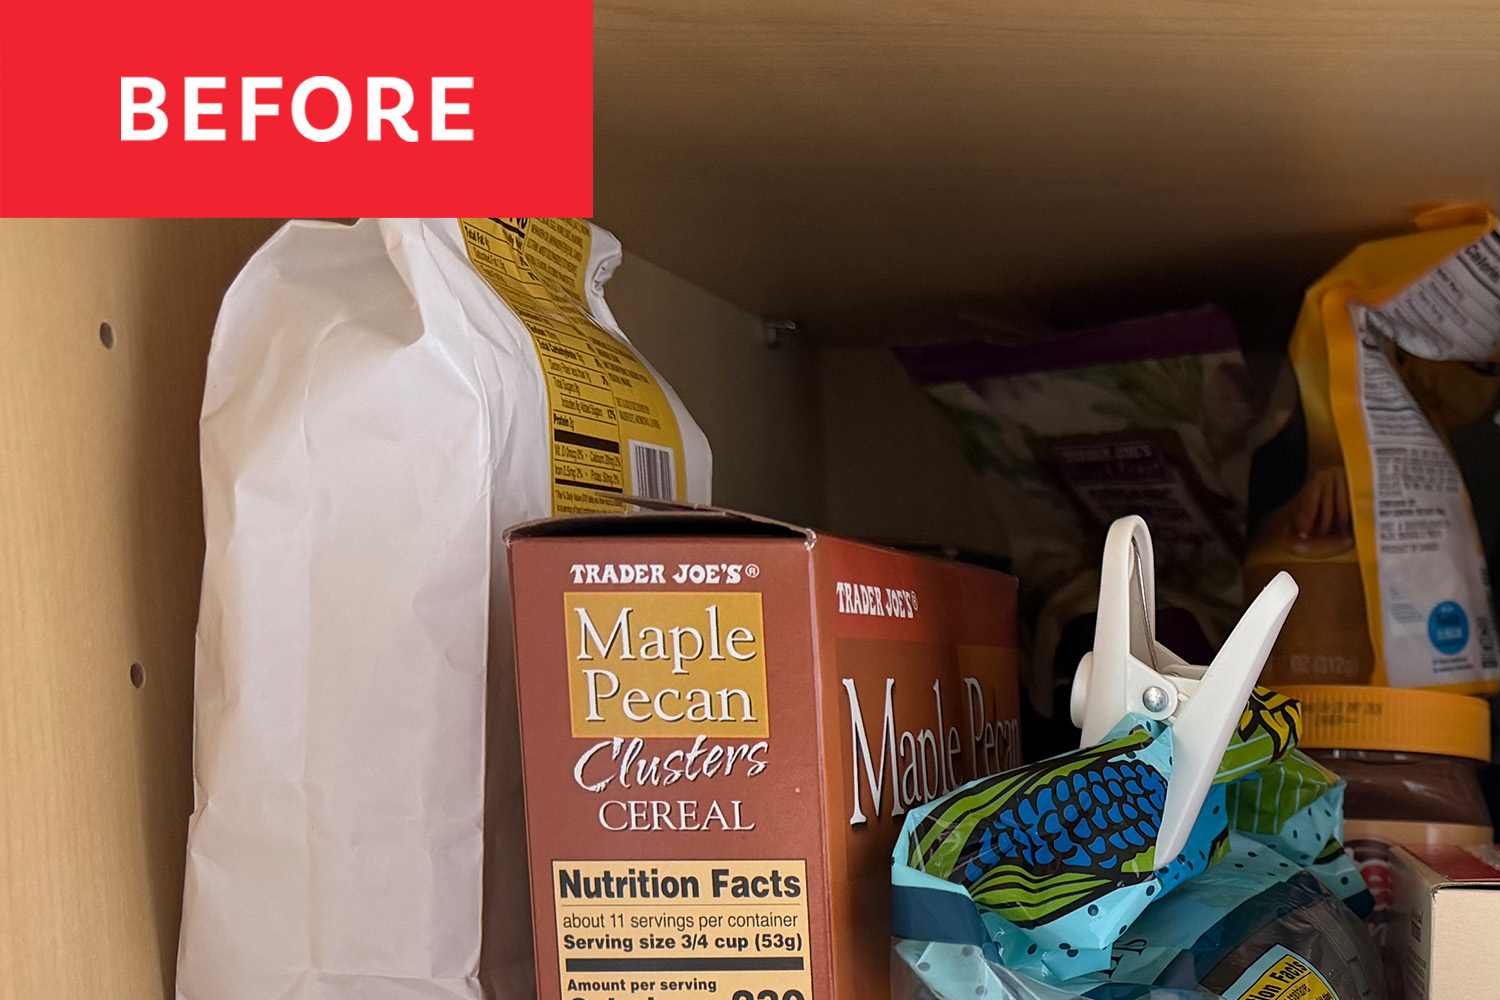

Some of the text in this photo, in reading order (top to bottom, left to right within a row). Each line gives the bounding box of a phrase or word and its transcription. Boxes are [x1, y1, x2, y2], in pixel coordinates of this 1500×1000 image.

[570, 564, 665, 584] TRADER
[836, 581, 885, 618] TRADER
[573, 604, 757, 676] Maple
[581, 668, 758, 722] Pecan
[573, 735, 769, 792] Clusters
[598, 799, 755, 831] CEREAL
[559, 868, 801, 898] Nutrition Facts
[563, 911, 799, 932] about 11 servings per container
[564, 933, 802, 952] Serving size 3/4 cup (53g)
[567, 978, 717, 993] Amount per serving
